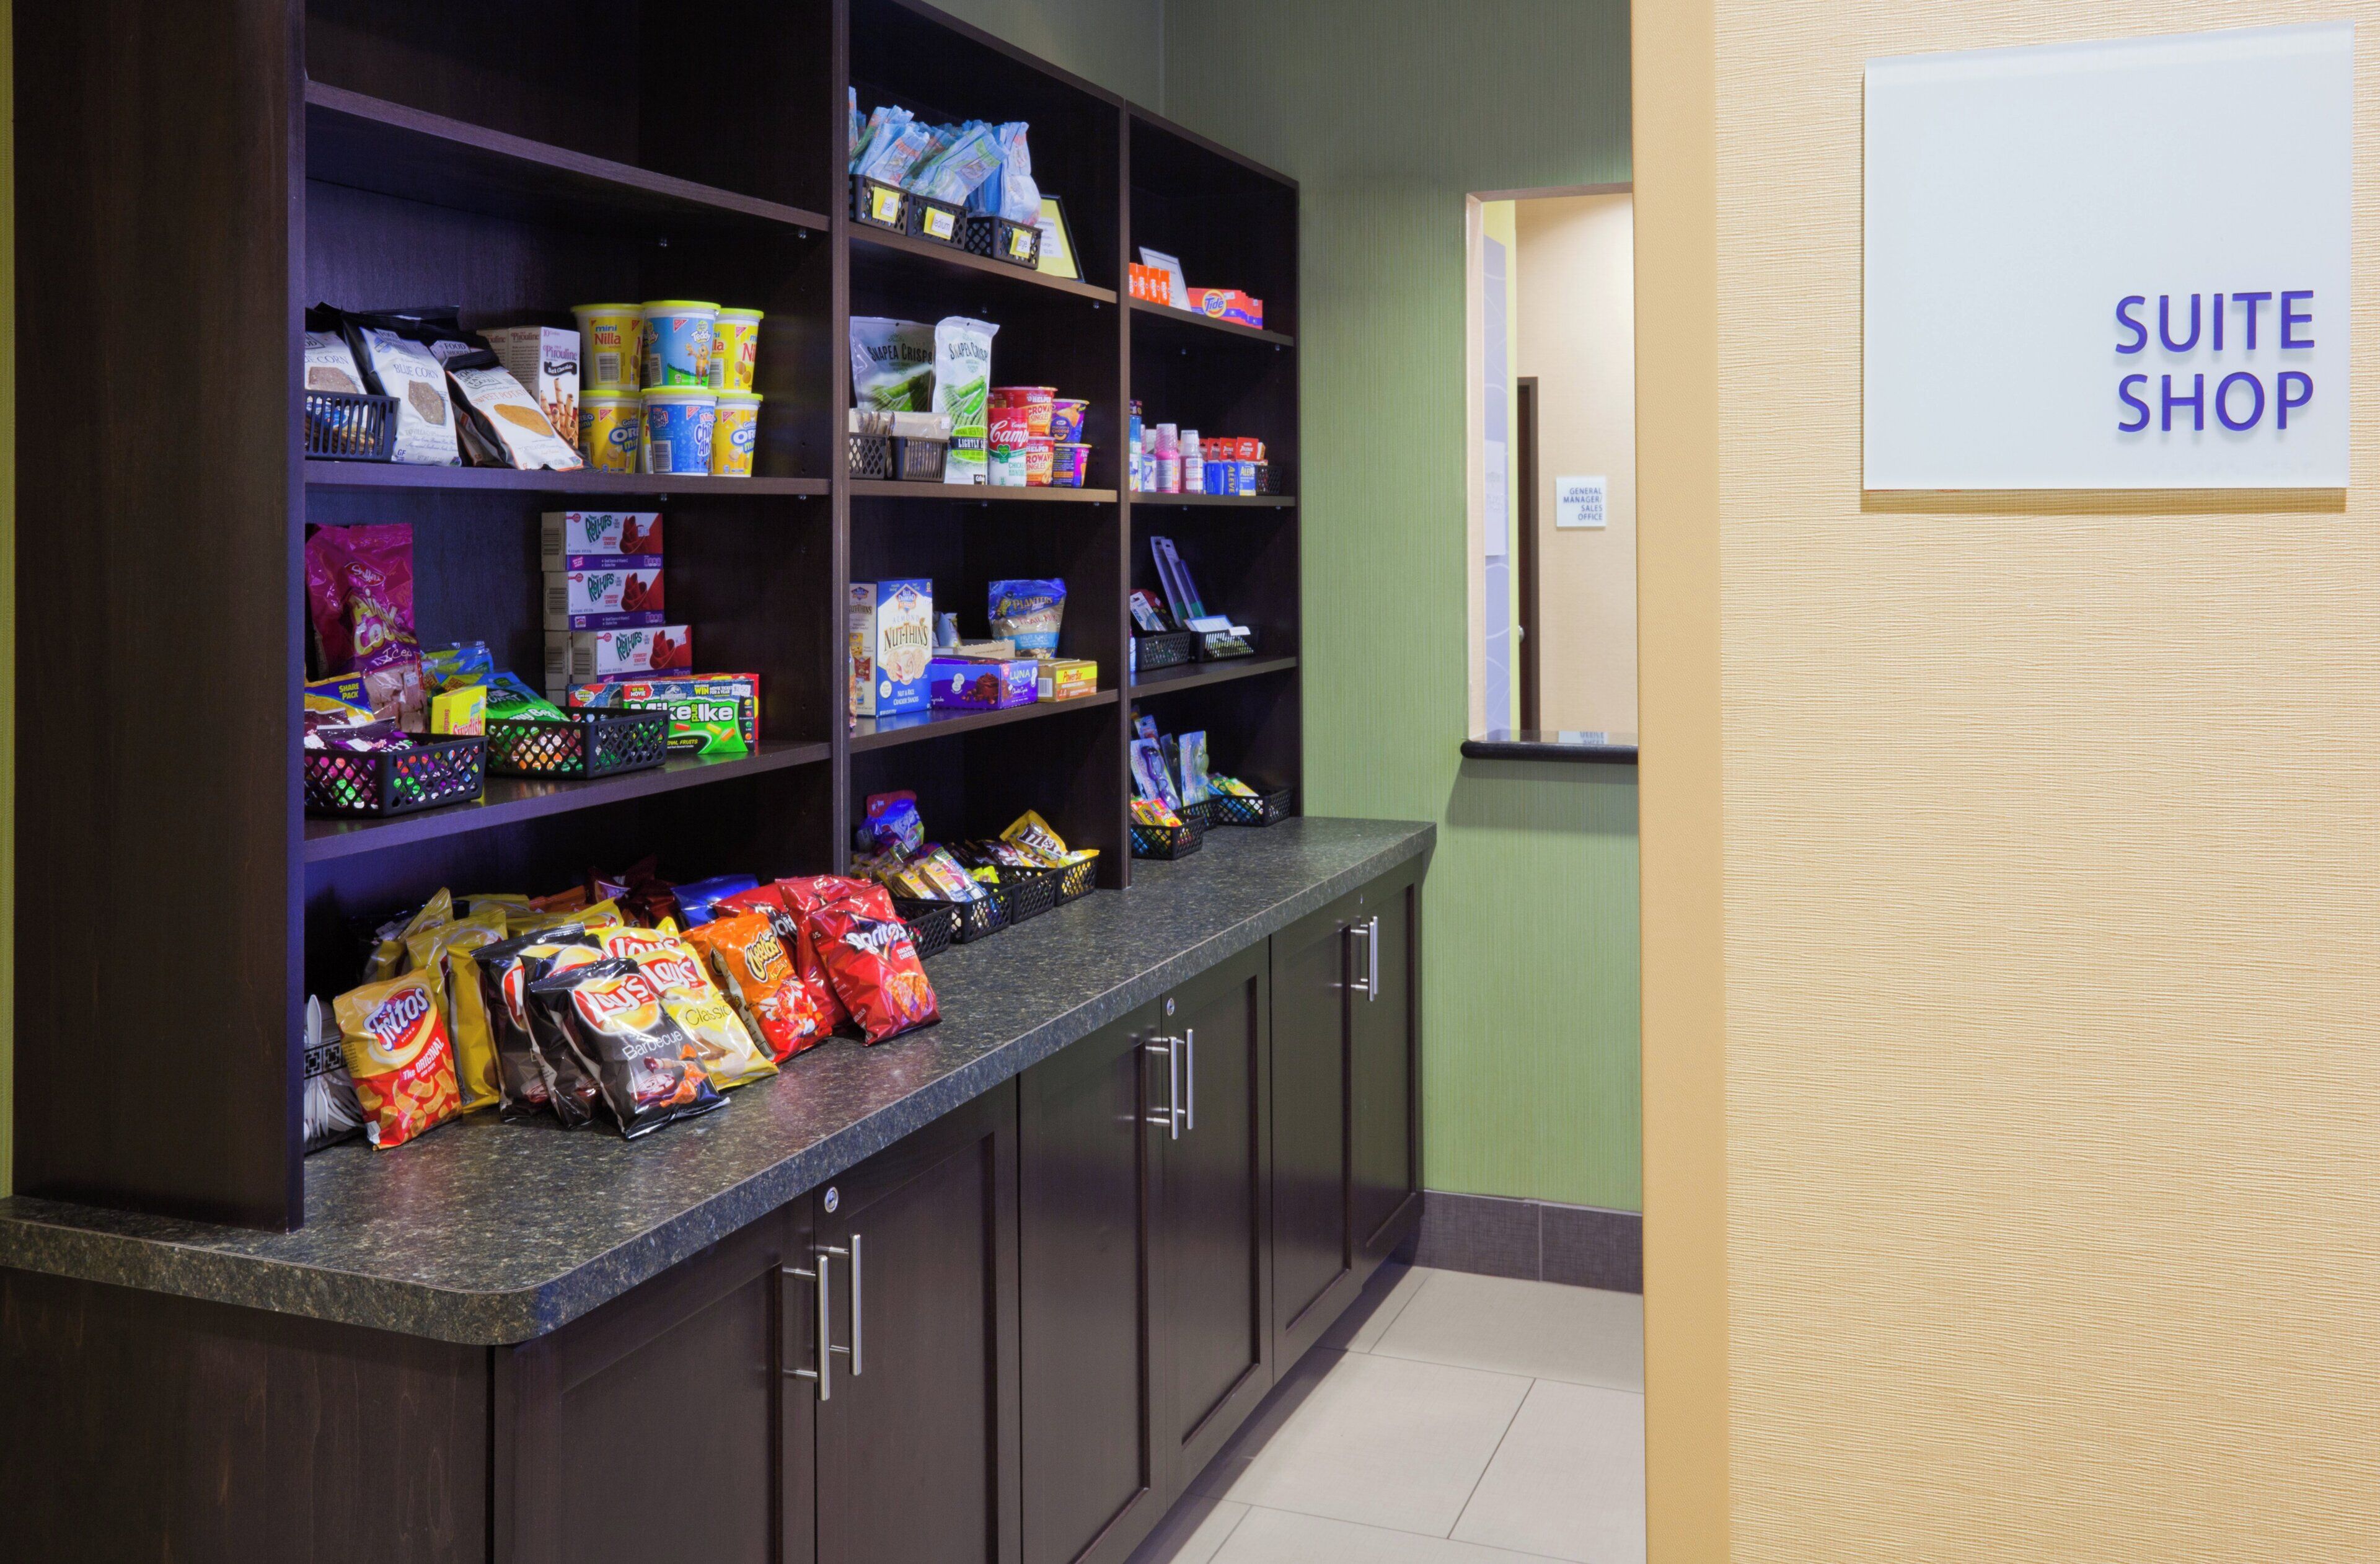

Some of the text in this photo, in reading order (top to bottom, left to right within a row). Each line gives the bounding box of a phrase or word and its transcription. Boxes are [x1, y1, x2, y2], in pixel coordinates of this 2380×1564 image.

[932, 219, 950, 232] edium
[1205, 298, 1224, 312] Tide
[2115, 290, 2315, 355] SUITE
[511, 332, 539, 341] Pirouline
[594, 333, 621, 345] Nilla
[691, 330, 712, 342] Teddy
[543, 345, 578, 361] Pirouline
[866, 343, 933, 365] SNAPEA CRISPS
[949, 342, 989, 363] SNAPEA CRISP
[317, 355, 350, 365] CORN
[393, 364, 439, 379] BLUE CORN
[2118, 371, 2314, 433] SHOP
[958, 438, 979, 448] LIGHTLY
[1027, 462, 1046, 471] INGLES
[1240, 466, 1255, 477] ALEVE
[585, 515, 612, 543] ROLL-UPS
[588, 573, 614, 603] ROLL-UPS
[1011, 597, 1053, 610] PLANTERS
[892, 614, 919, 624] ALMOND
[1018, 613, 1057, 625] TRAIL MIX
[616, 632, 643, 661] ROLL-UPS
[1010, 669, 1030, 683] LUNA
[338, 683, 359, 693] SHARE
[695, 687, 709, 695] WIN
[342, 691, 358, 700] PACK
[893, 696, 919, 706] CRACKER SNACKS
[698, 703, 734, 722] Ike
[846, 922, 907, 955] Doritos
[640, 957, 696, 994] Lay's
[581, 976, 649, 1023] Lay's
[363, 987, 430, 1051] Fritos
[685, 1004, 732, 1026] Classic
[622, 1030, 683, 1061] Barbecue
[403, 1036, 444, 1080] The ORIGINAL
